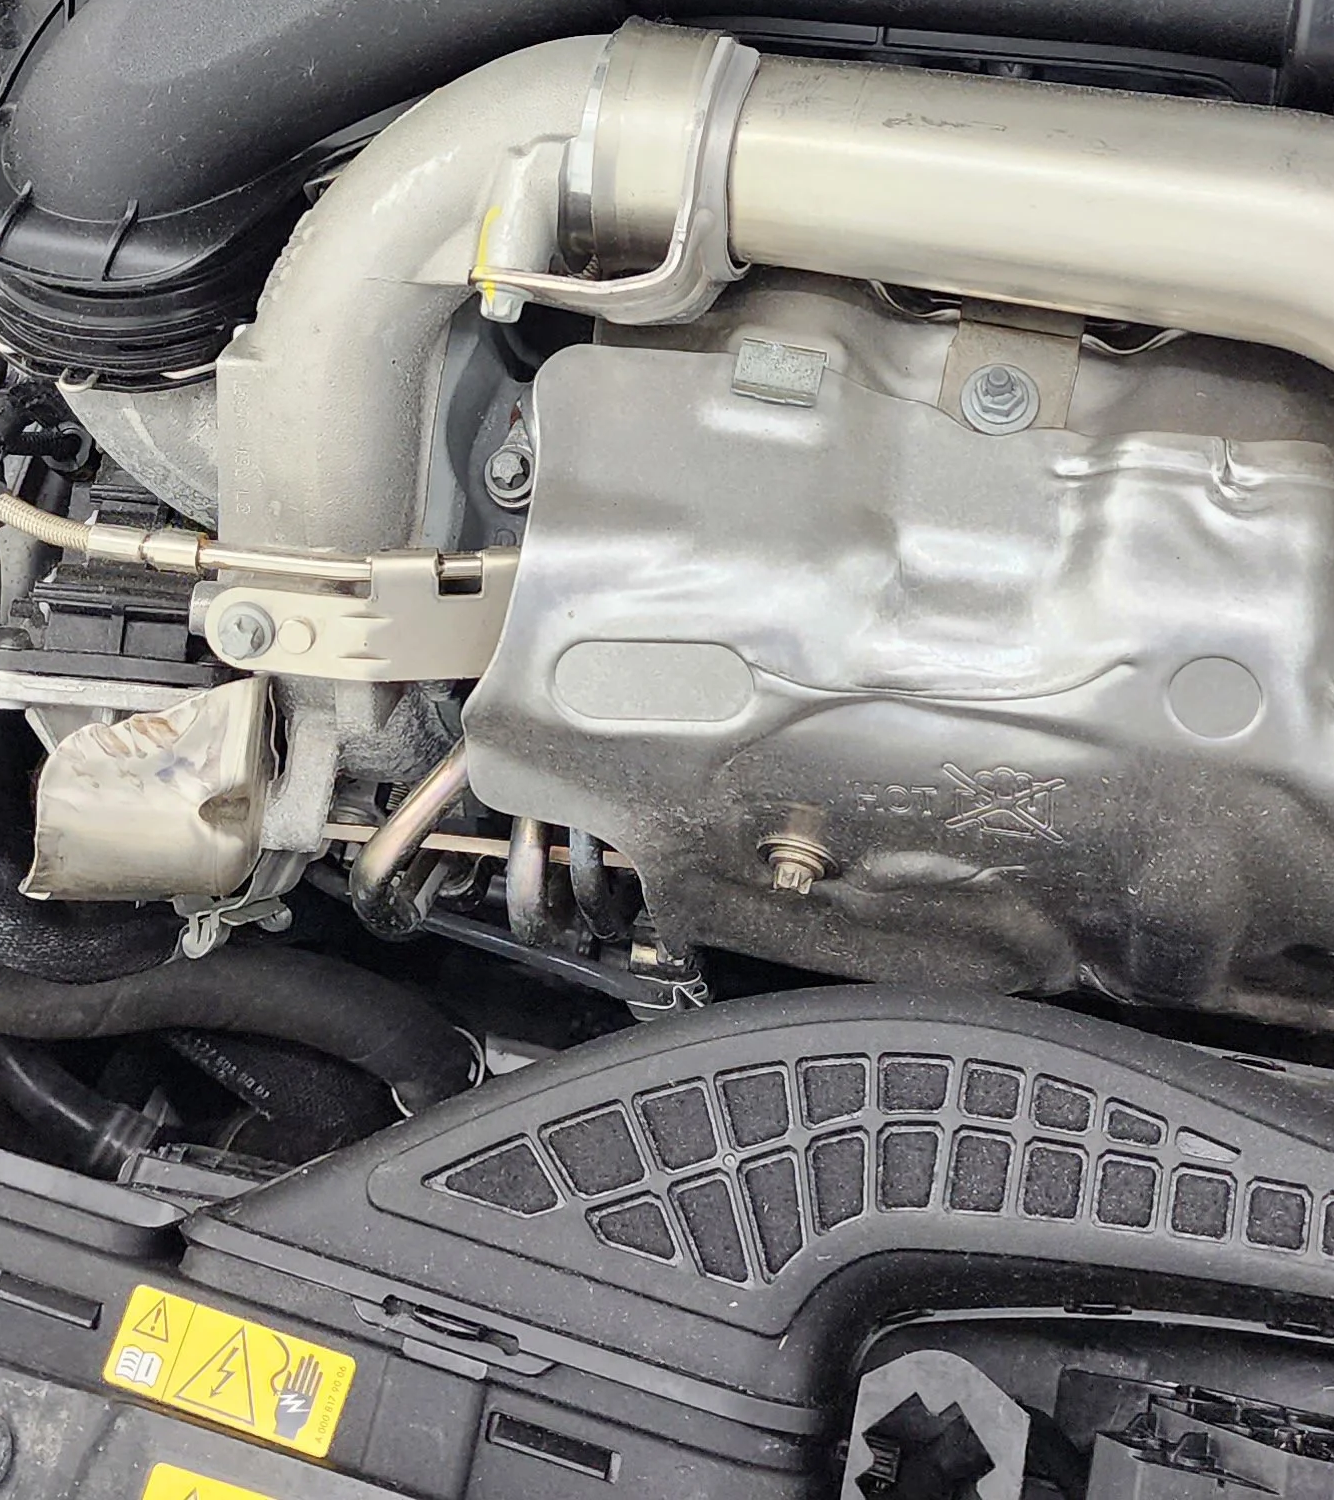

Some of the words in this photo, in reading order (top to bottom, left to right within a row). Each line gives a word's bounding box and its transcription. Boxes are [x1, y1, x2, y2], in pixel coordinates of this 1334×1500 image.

[853, 783, 937, 816] HOT
[318, 1414, 329, 1434] 000
[325, 1395, 335, 1412] 817
